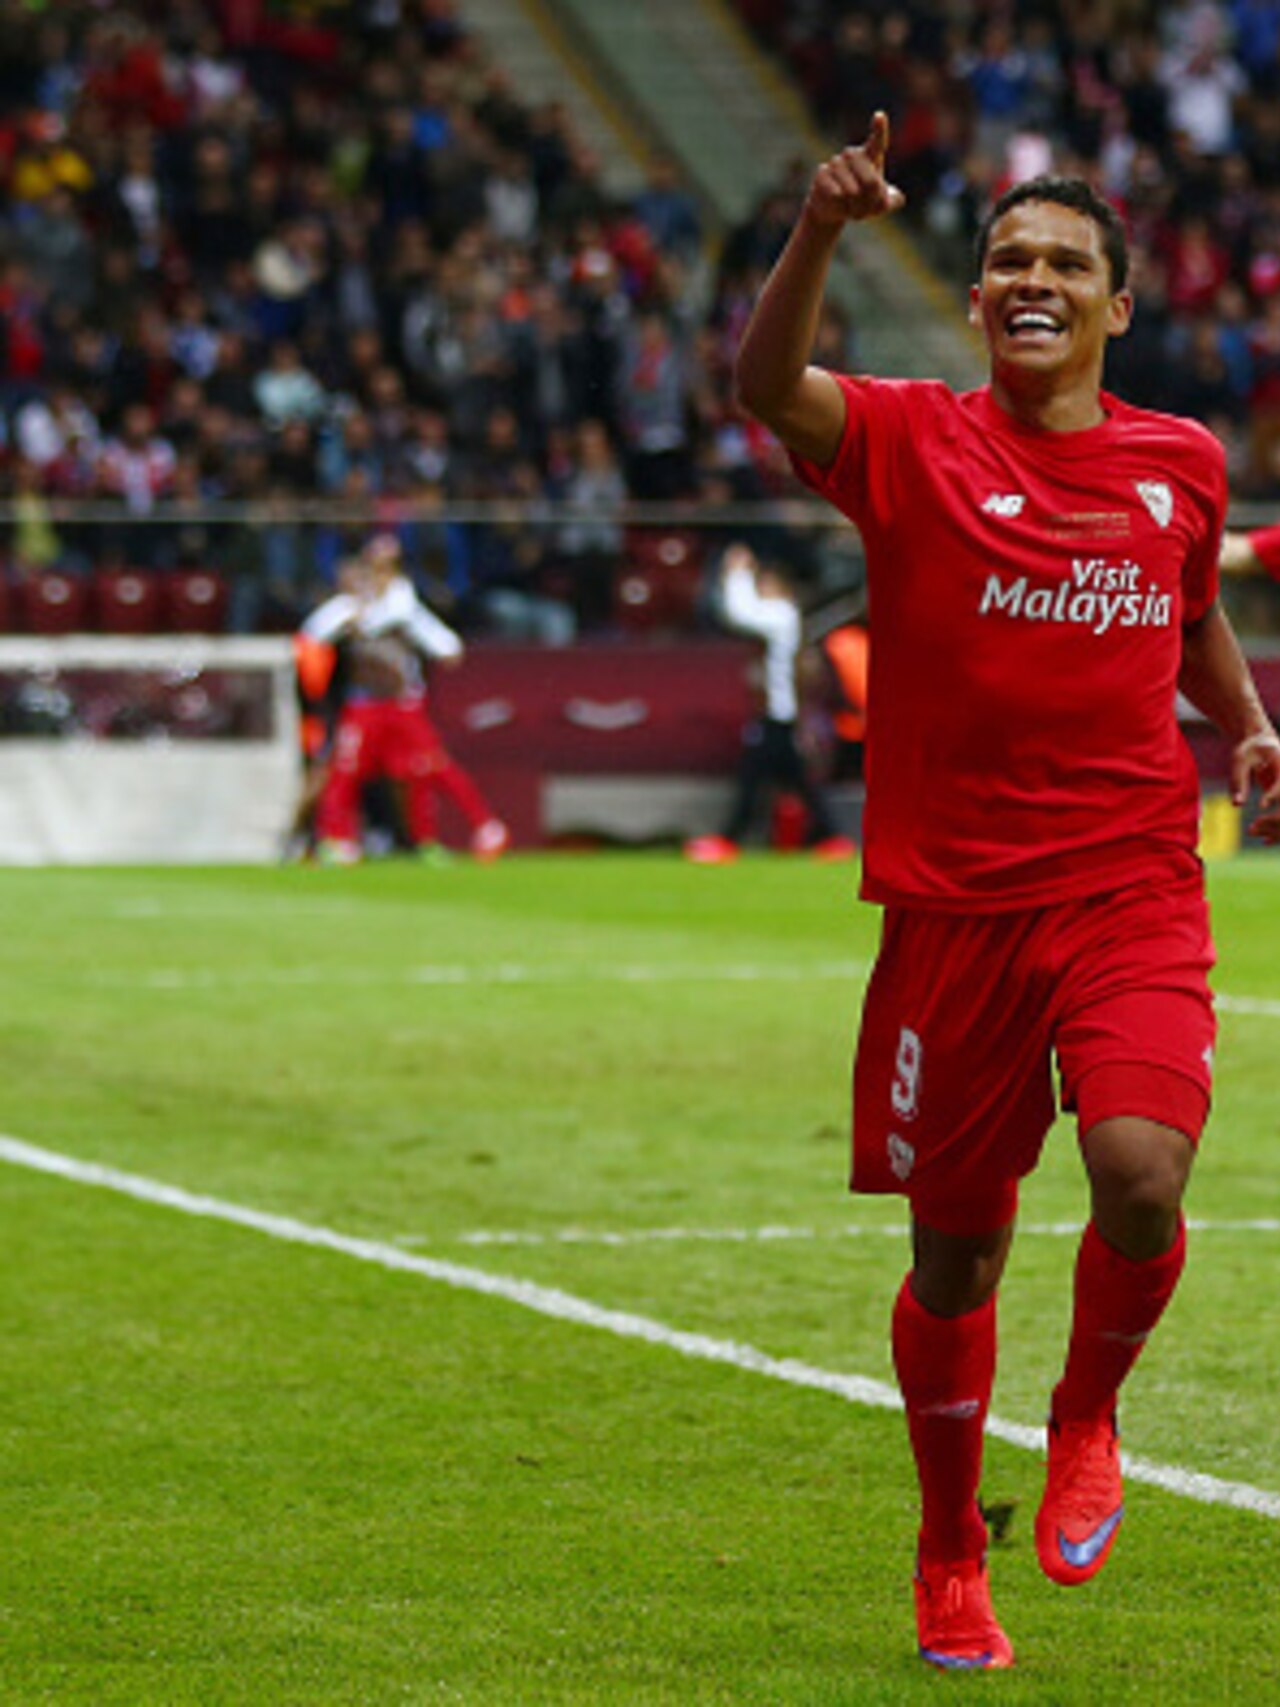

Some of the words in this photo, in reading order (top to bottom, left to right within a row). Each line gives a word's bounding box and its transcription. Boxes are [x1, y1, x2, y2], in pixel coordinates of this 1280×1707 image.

[978, 573, 1173, 635] Malaysia
[1072, 559, 1141, 591] Visit
[891, 1026, 921, 1117] 9
